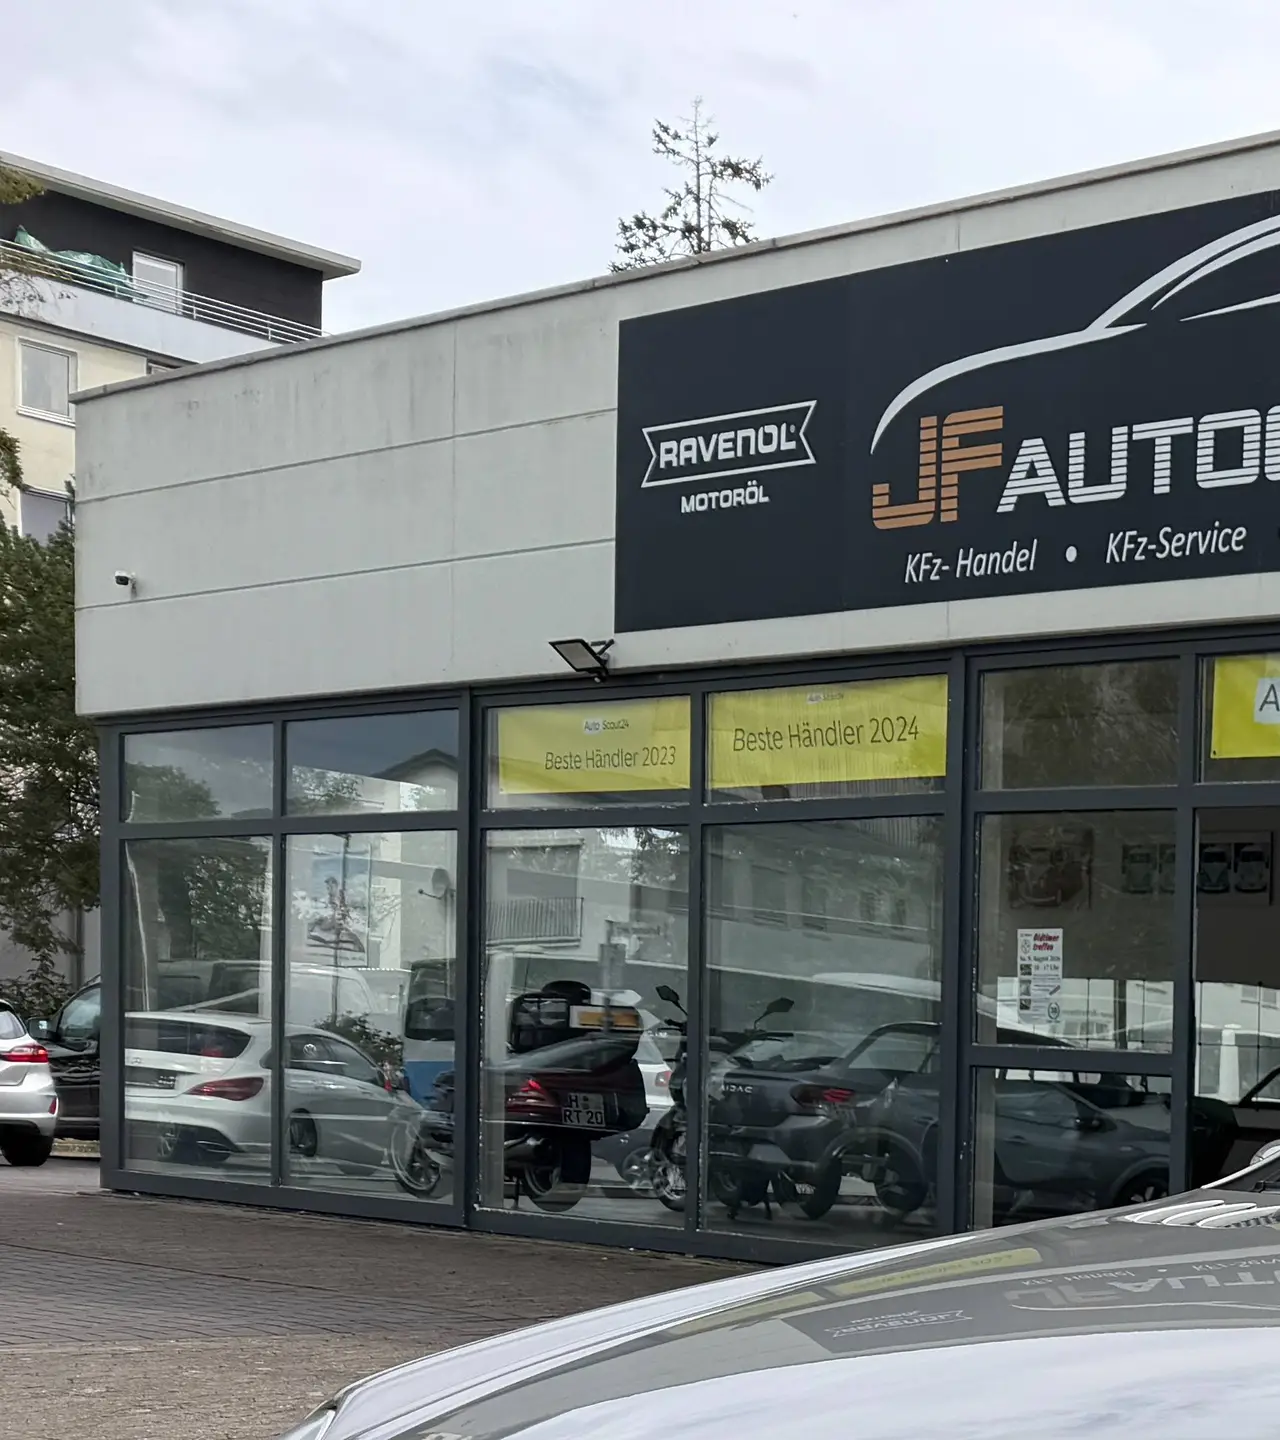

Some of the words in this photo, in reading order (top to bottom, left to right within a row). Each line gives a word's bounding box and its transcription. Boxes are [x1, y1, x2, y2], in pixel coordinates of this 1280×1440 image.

[659, 422, 796, 469] RAVENOL
[872, 406, 1003, 528] JF
[681, 480, 769, 513] MOTORÖL
[956, 539, 1038, 579] Handel
[1105, 519, 1247, 563] KFz-Service
[733, 728, 783, 751] Beste
[788, 720, 864, 748] Händler
[869, 715, 919, 743] 2024
[545, 752, 582, 770] Beste
[585, 748, 639, 769] Händler
[642, 746, 676, 766] 2023
